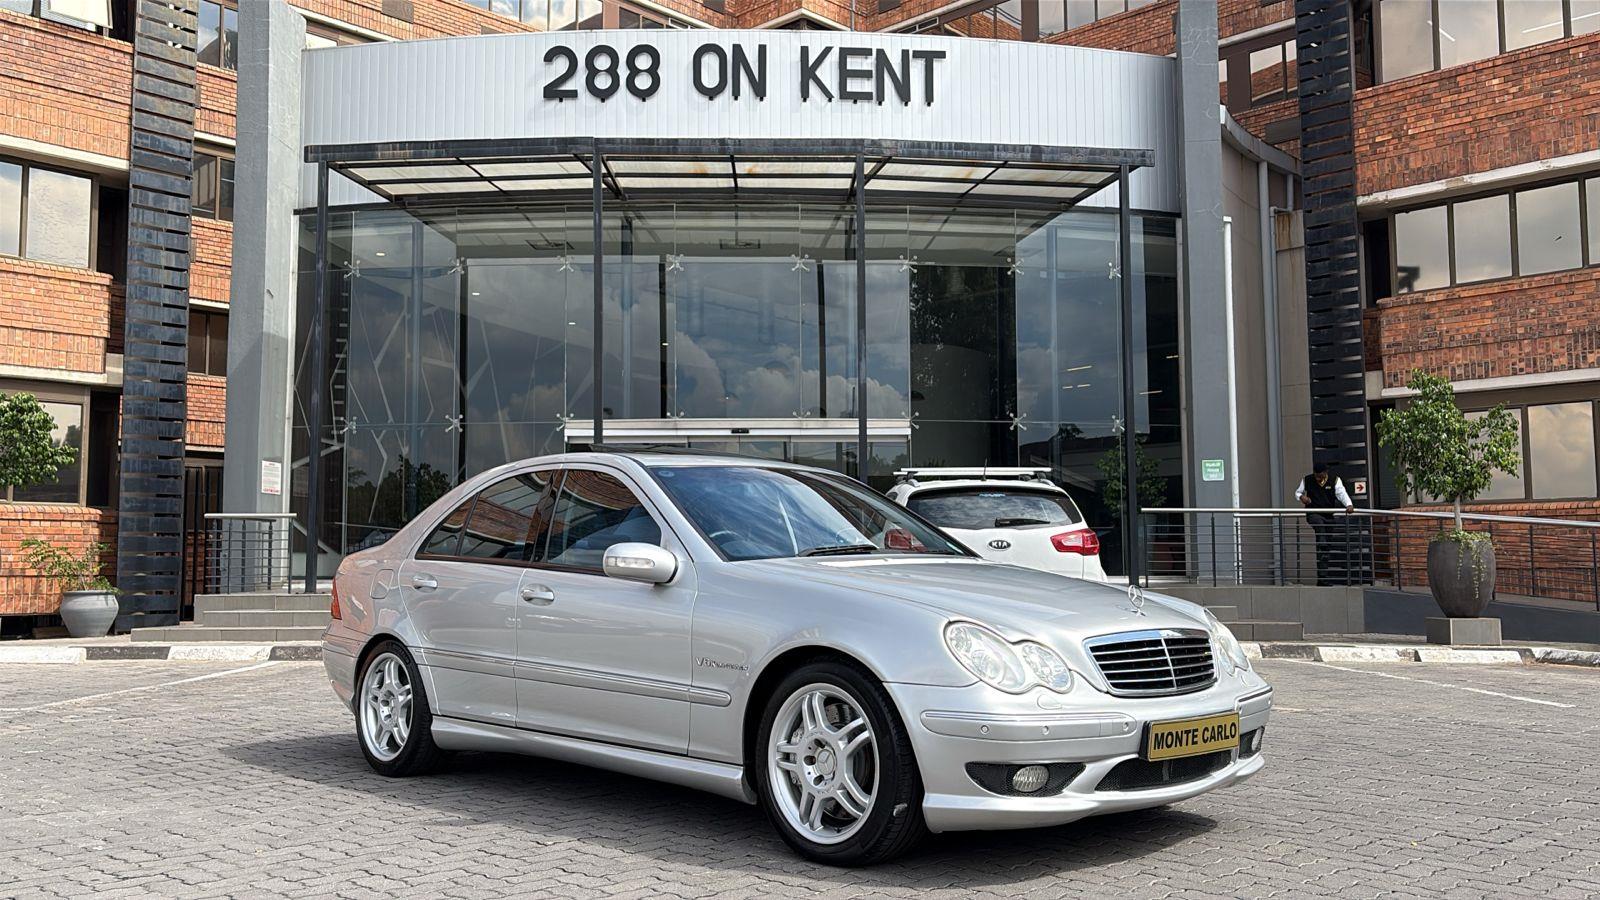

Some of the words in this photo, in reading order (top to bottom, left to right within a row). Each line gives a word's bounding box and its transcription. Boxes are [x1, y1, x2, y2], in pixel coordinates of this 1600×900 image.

[543, 44, 660, 99] 288
[693, 43, 767, 98] ON
[800, 46, 946, 102] KENT
[991, 540, 1008, 549] KIA
[1153, 728, 1199, 750] MONTE
[1202, 722, 1237, 743] CARLO
